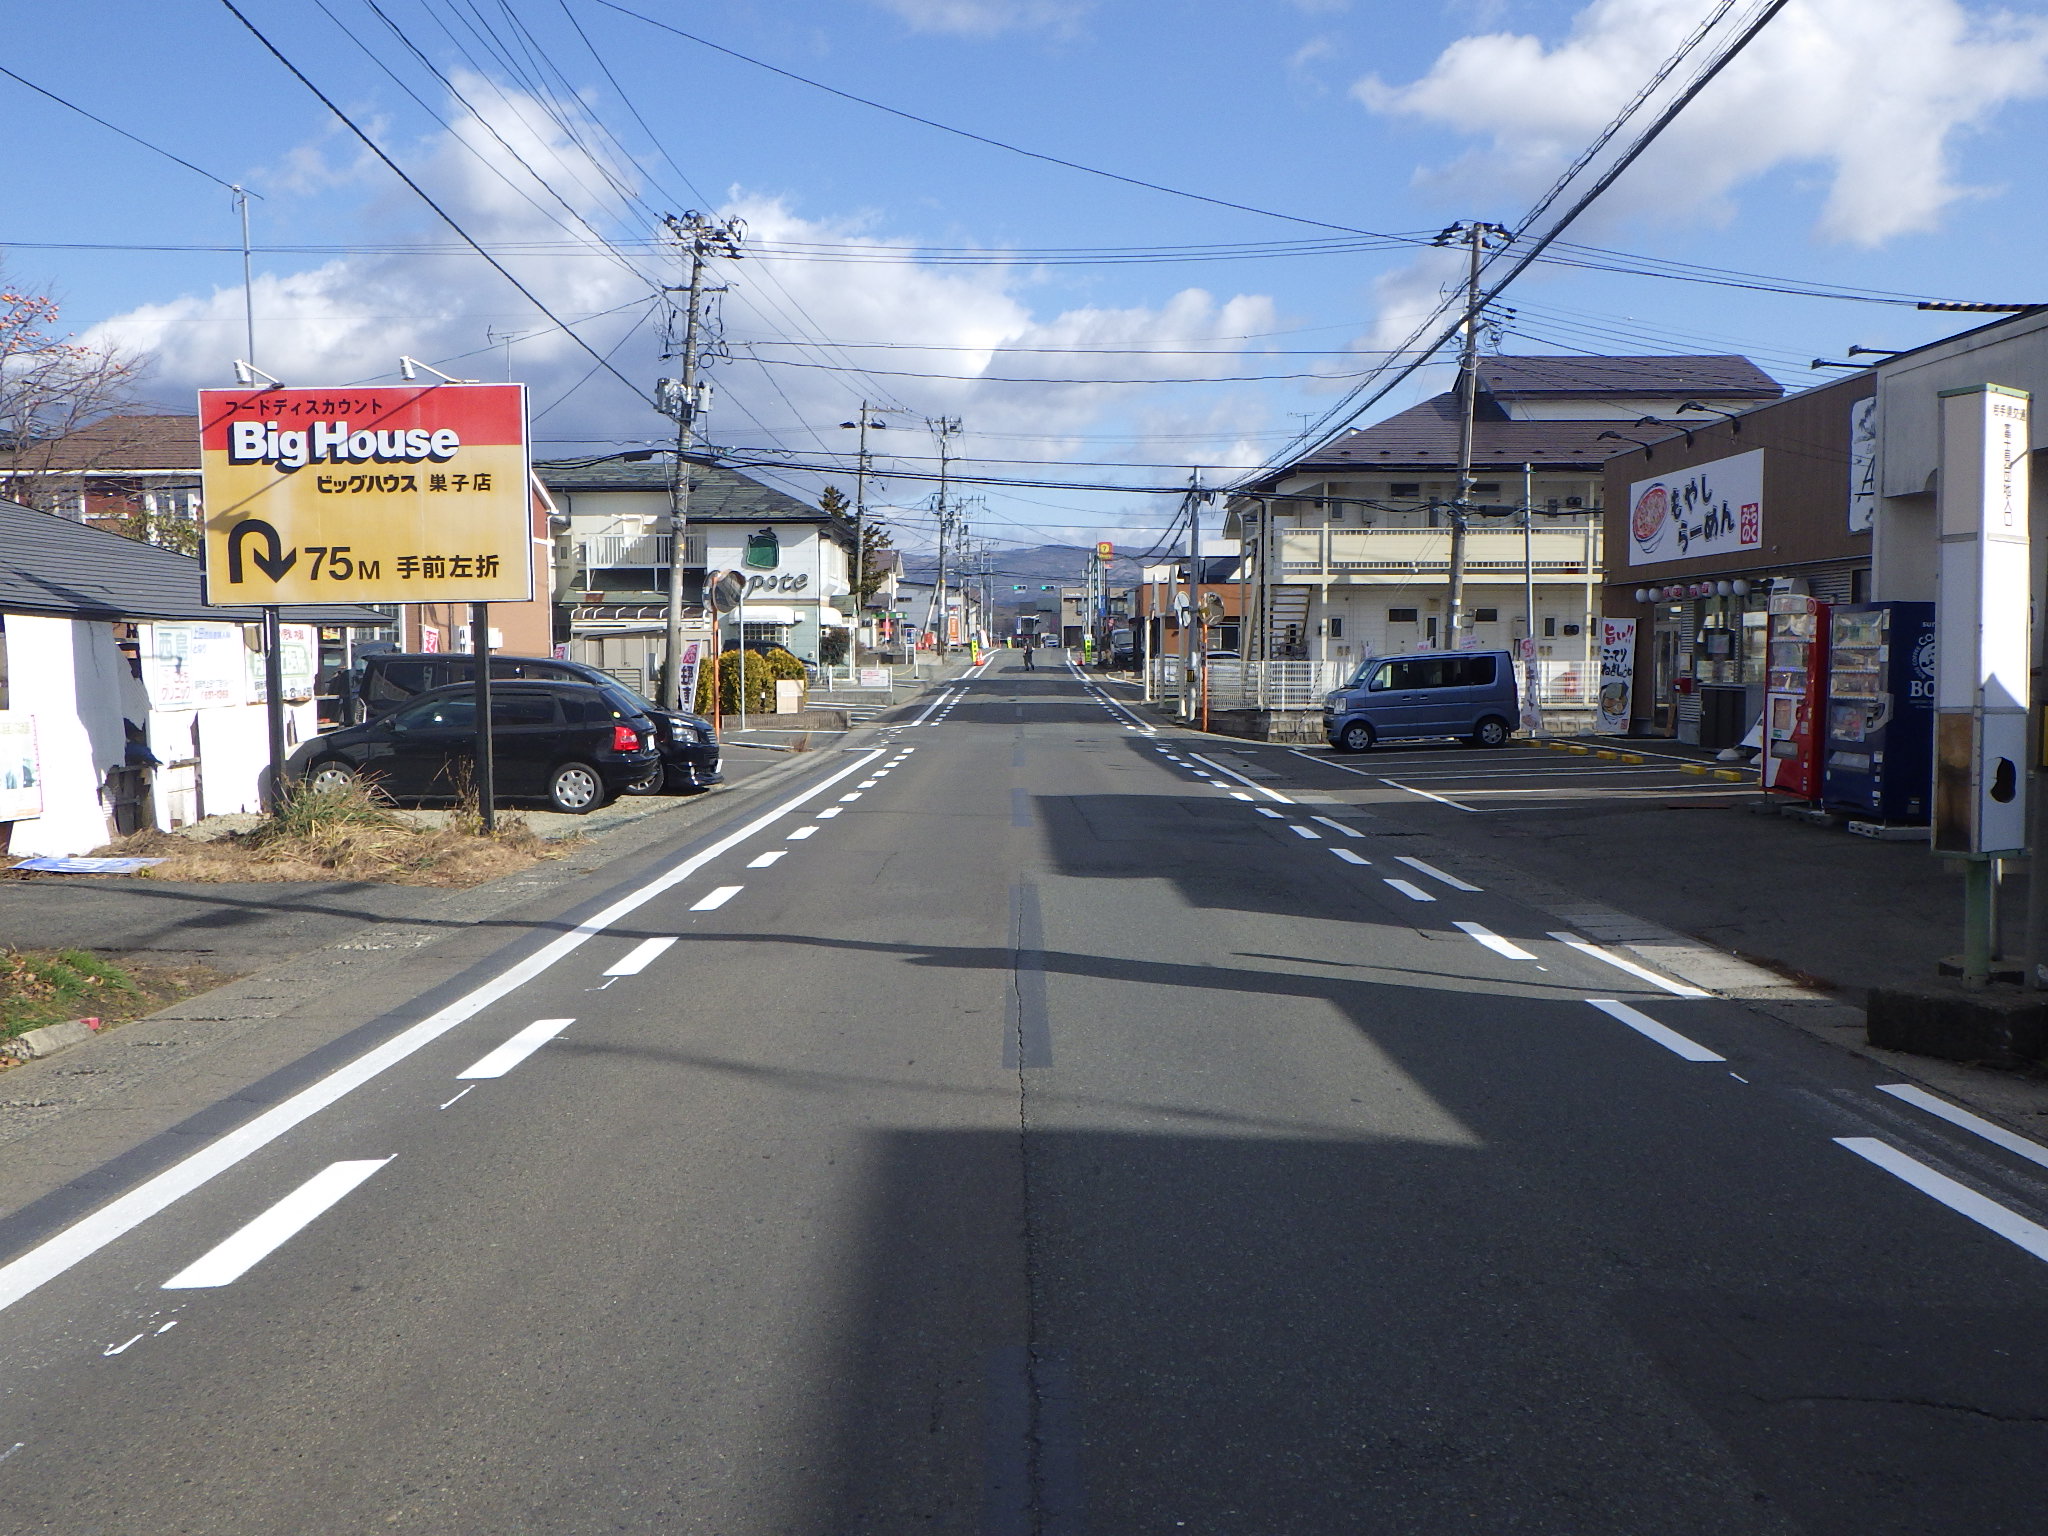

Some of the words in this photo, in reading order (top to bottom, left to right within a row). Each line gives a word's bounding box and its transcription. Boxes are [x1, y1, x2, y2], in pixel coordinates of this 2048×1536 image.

[225, 398, 383, 417] フードディスカウント
[229, 421, 308, 471] Big
[312, 421, 460, 462] House
[317, 474, 418, 494] ビッグハウス
[429, 473, 492, 492] 巣子店
[1671, 474, 1713, 522] もやし
[1678, 500, 1735, 555] らーめん
[396, 555, 500, 580] 手前左折
